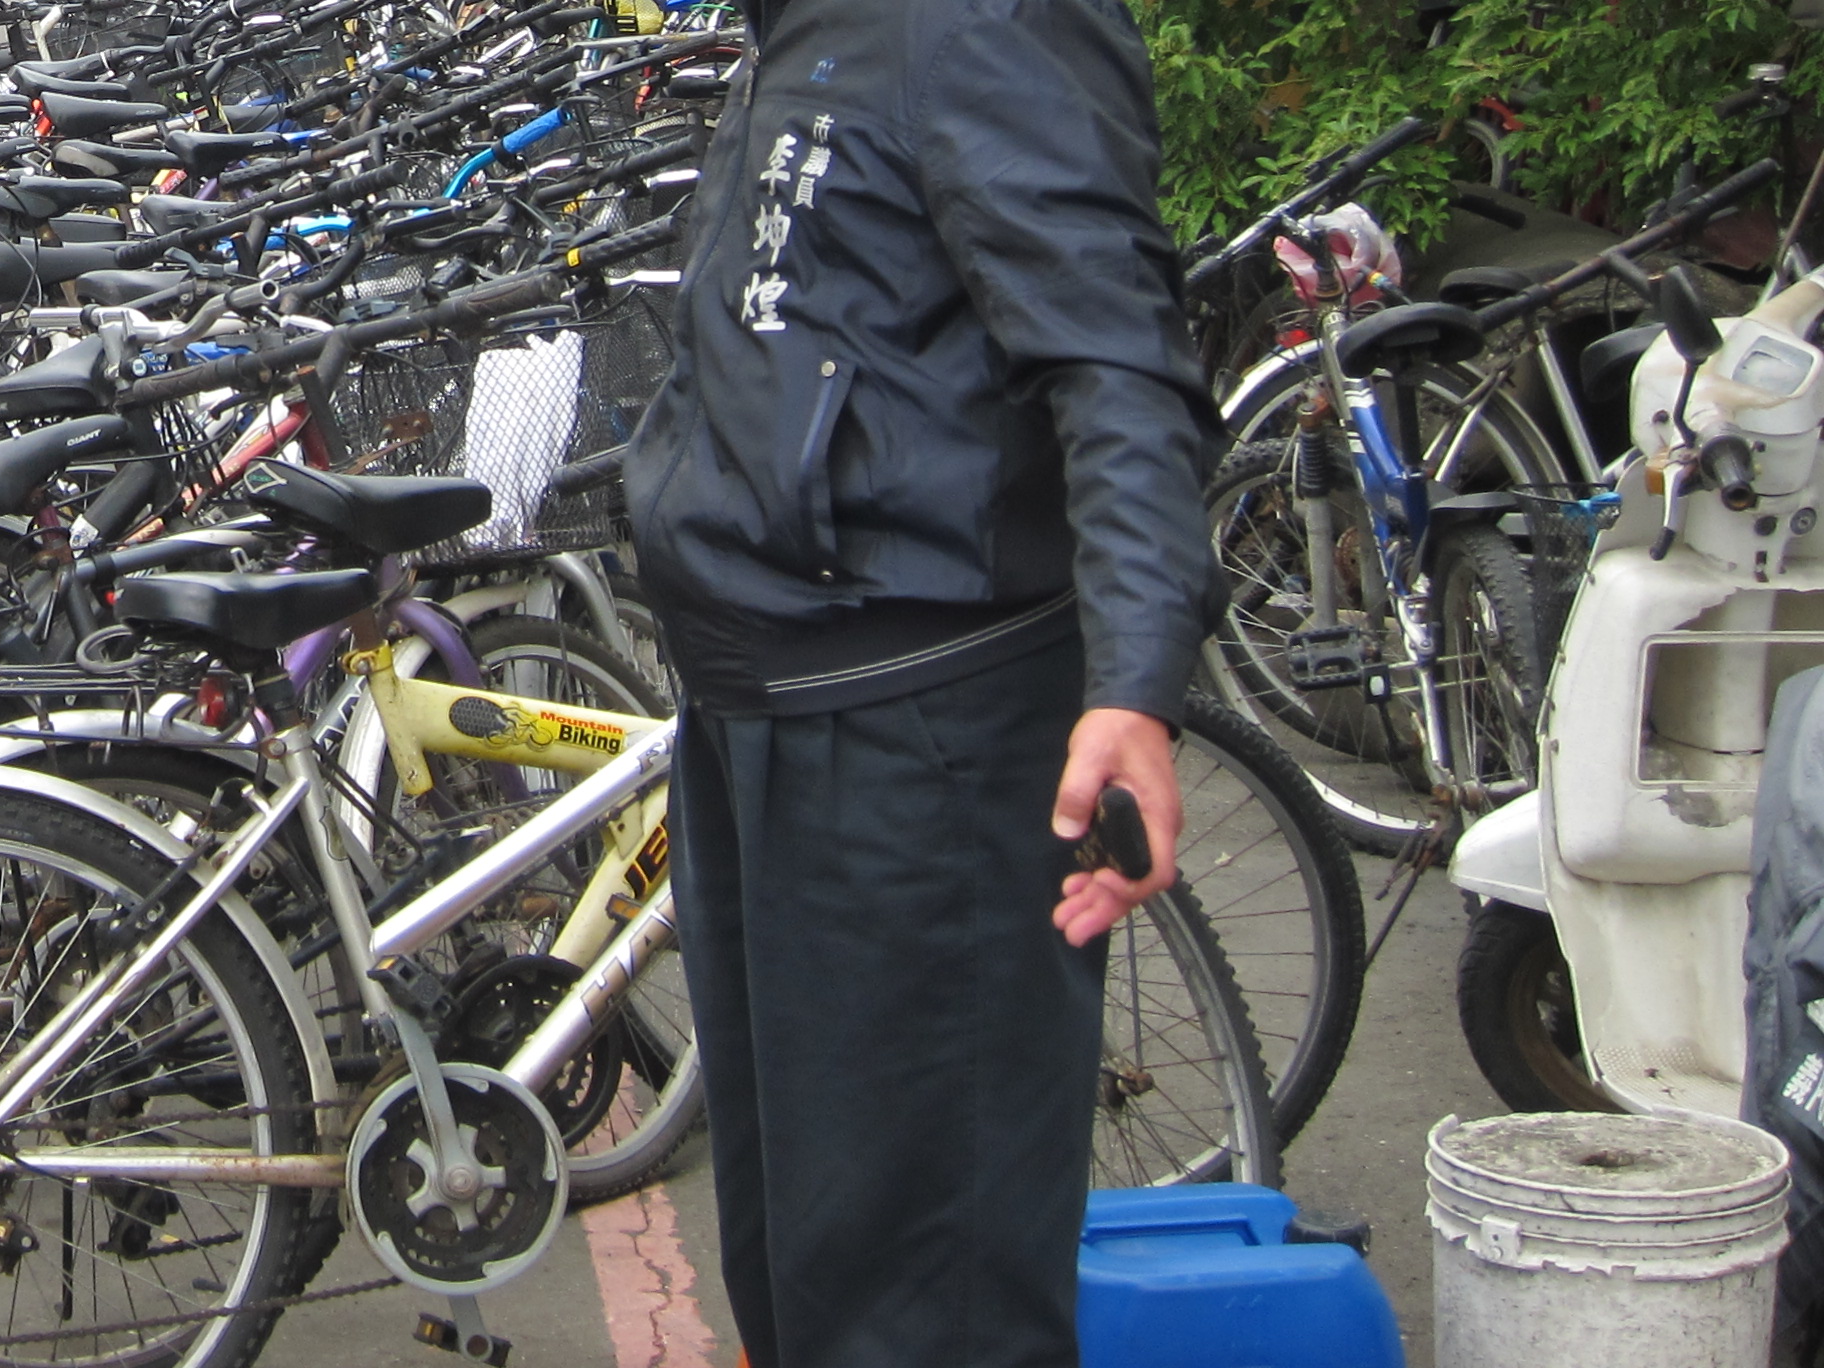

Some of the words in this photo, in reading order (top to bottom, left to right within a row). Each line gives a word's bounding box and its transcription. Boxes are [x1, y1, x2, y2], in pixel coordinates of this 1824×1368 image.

[66, 428, 102, 447] GIANT
[540, 711, 624, 735] Mountain
[558, 723, 621, 755] Biking
